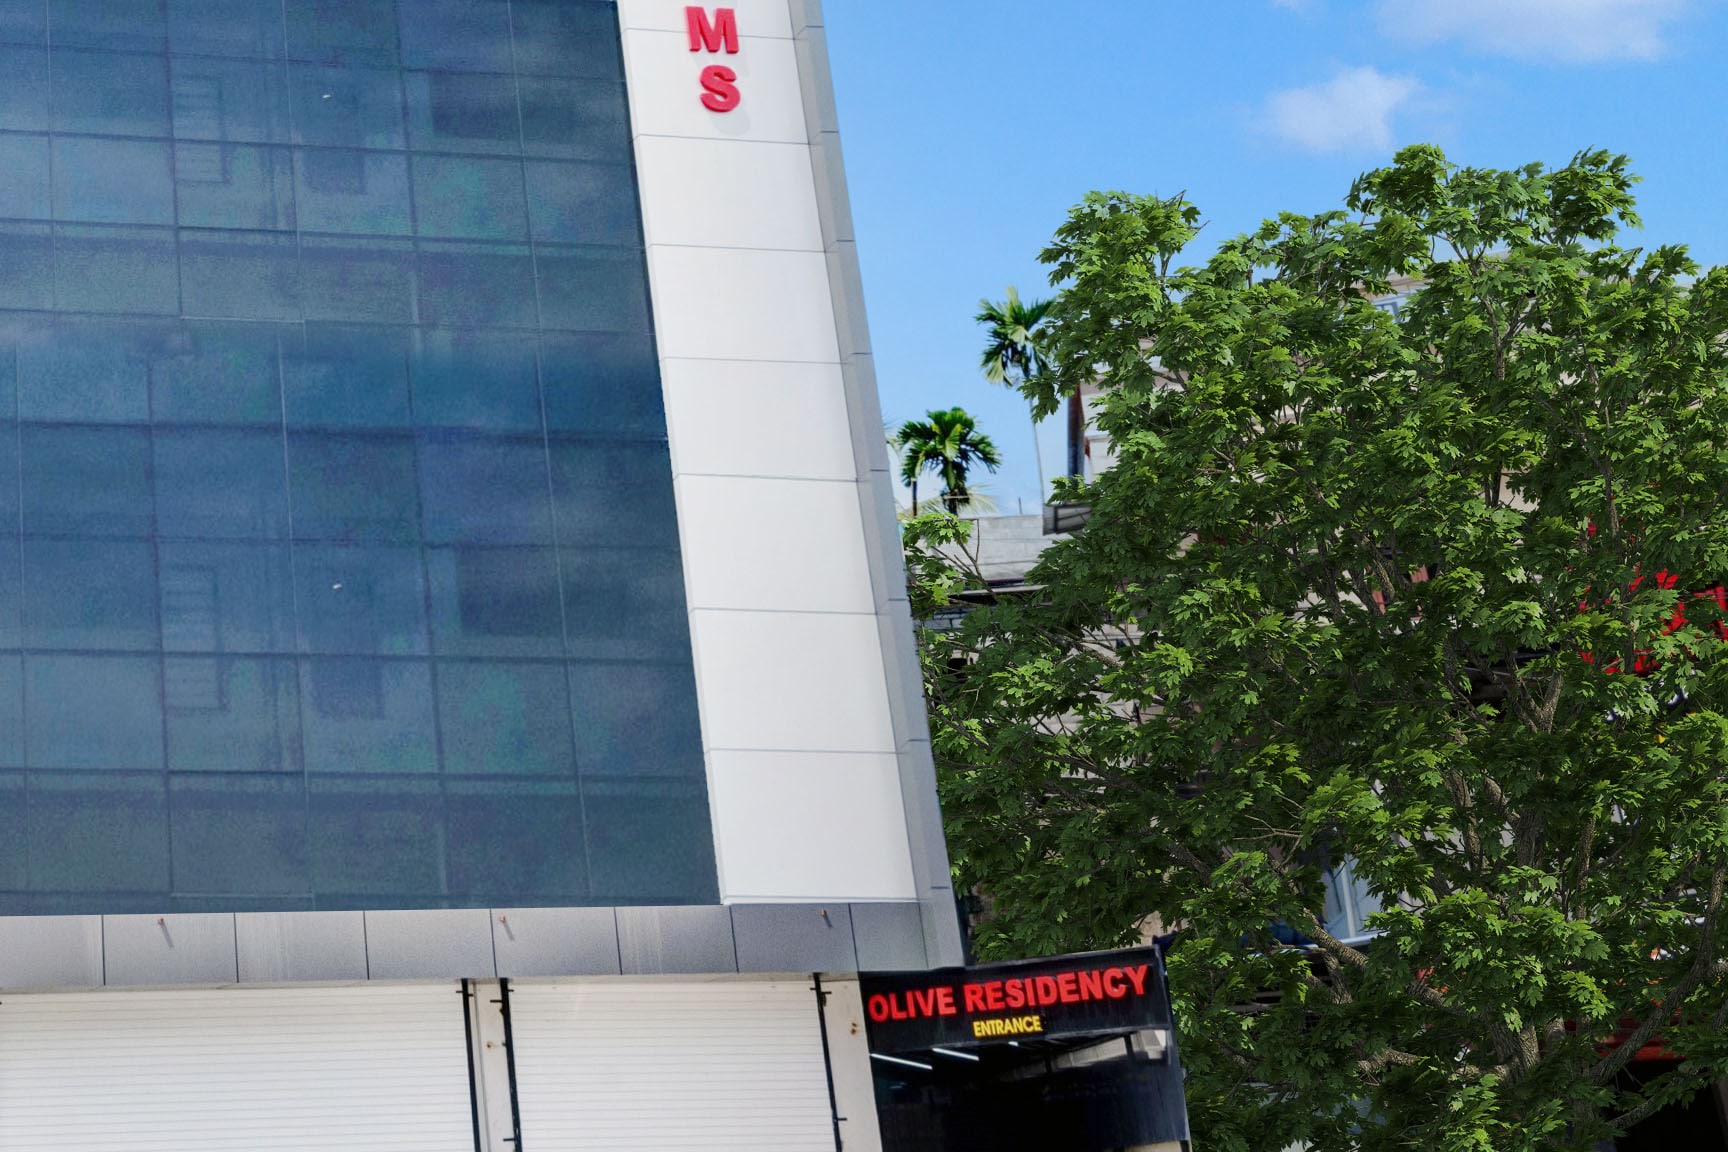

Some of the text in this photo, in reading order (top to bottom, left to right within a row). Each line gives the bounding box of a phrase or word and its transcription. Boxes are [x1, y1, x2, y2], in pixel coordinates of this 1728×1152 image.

[868, 964, 1148, 1022] OLIVE RESIDENCY
[973, 1015, 1043, 1037] ENTRANCE
